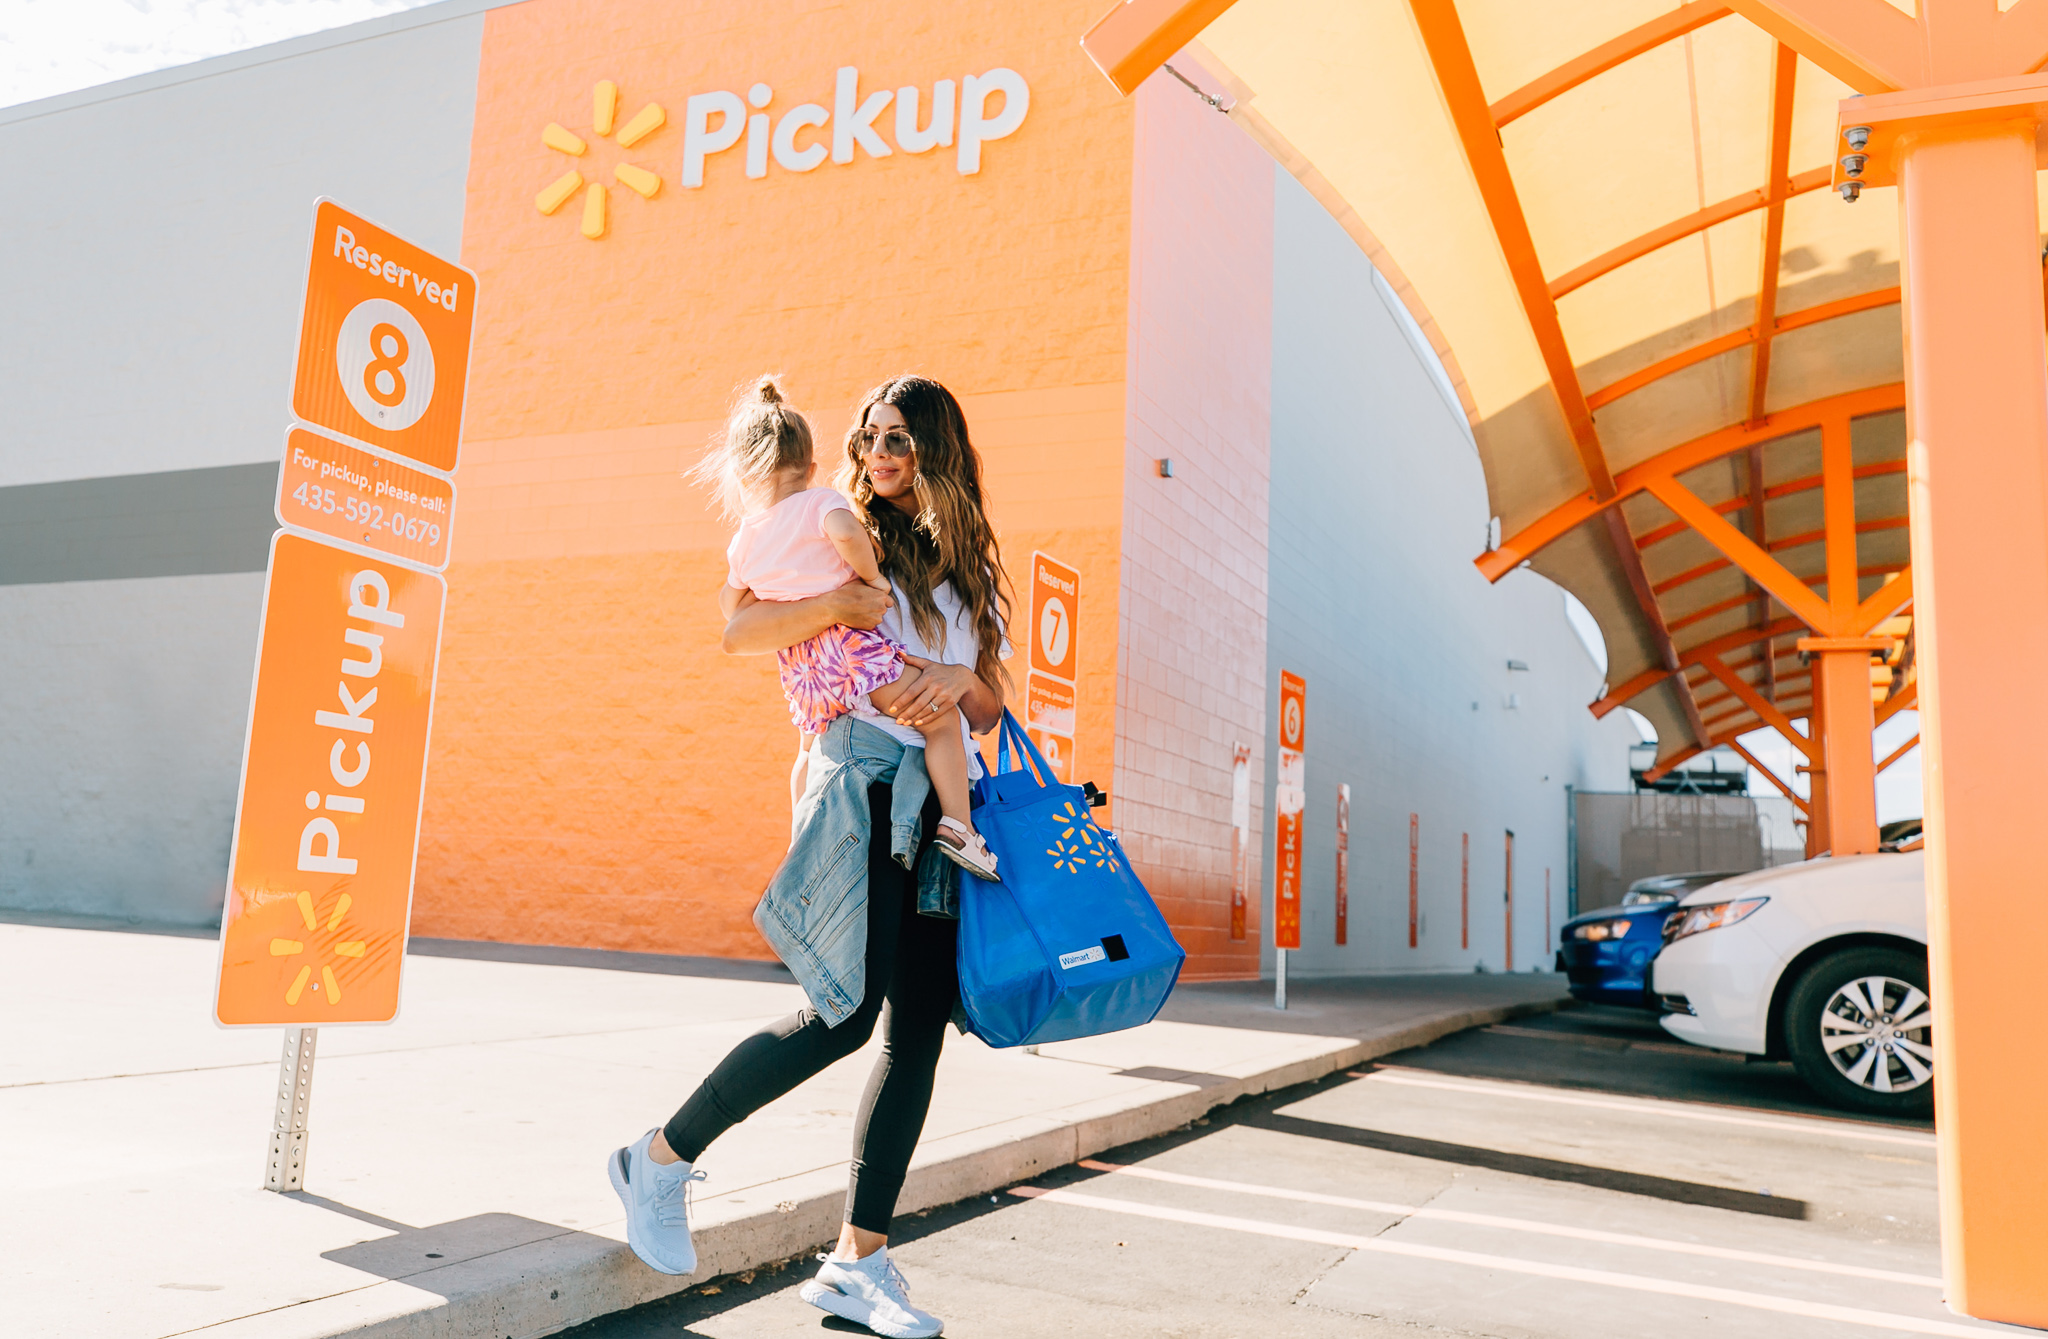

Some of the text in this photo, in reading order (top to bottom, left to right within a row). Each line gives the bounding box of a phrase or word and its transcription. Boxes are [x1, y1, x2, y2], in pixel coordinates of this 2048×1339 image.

[682, 65, 1030, 189] Pickup
[333, 224, 459, 313] Reserved
[363, 322, 409, 408] 8
[293, 447, 447, 514] For pickup, please call:
[292, 481, 441, 547] 435-592-0679
[1038, 564, 1075, 597] Reserved
[1049, 608, 1062, 651] 7
[296, 568, 405, 875] Pickup
[1288, 706, 1296, 735] 6
[1061, 952, 1090, 966] Walmart
